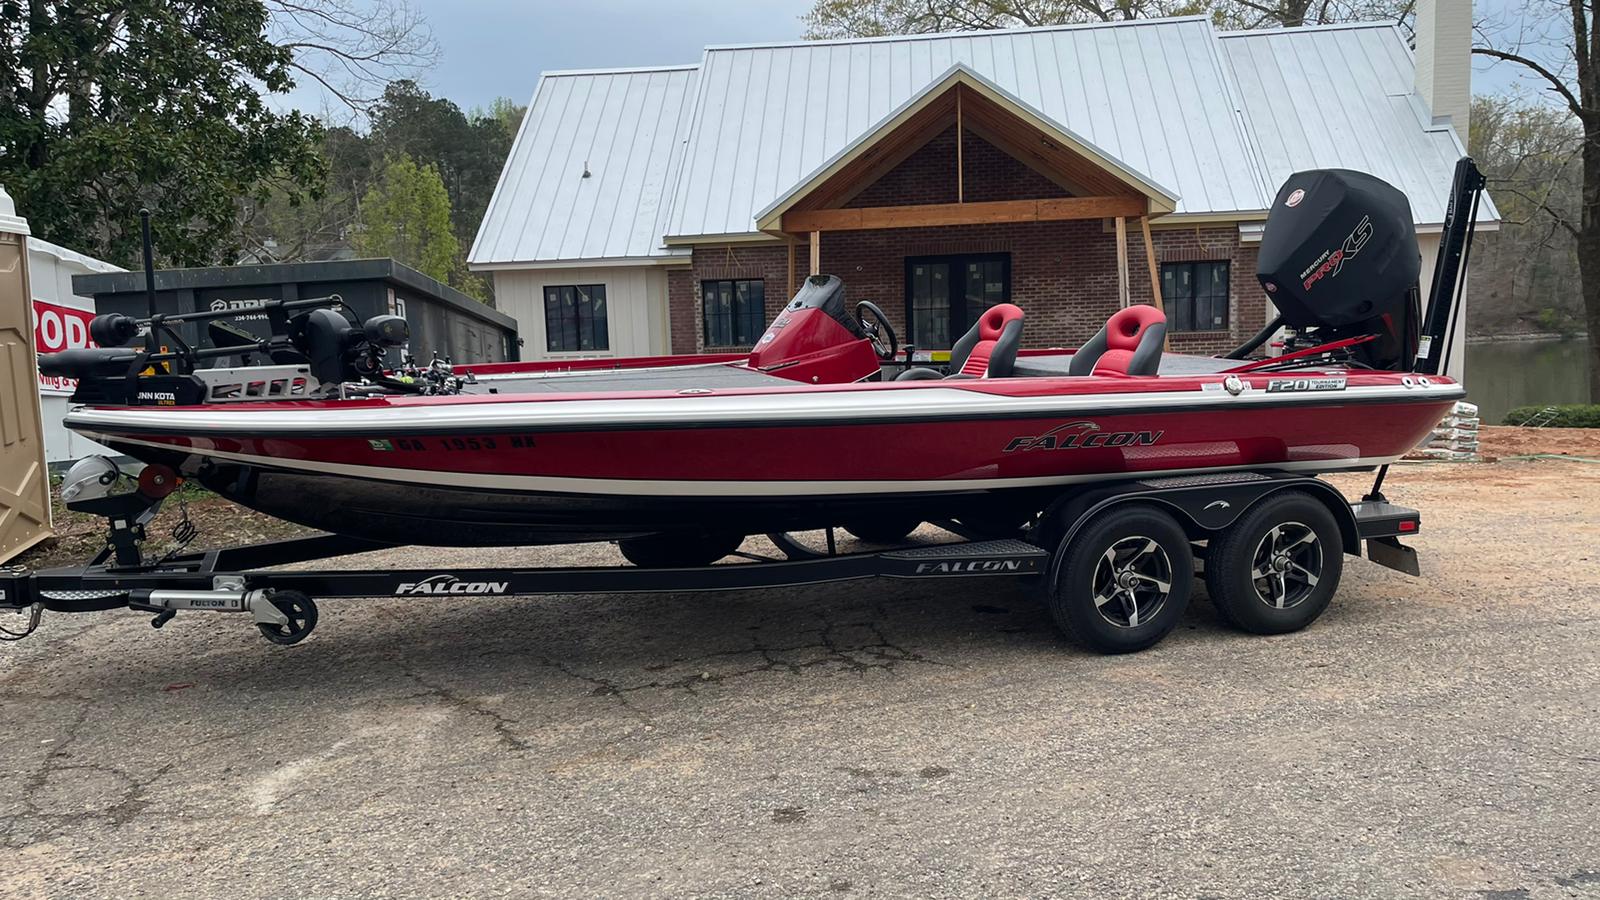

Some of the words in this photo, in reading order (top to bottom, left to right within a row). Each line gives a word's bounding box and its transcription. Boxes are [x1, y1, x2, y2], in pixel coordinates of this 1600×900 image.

[1300, 249, 1330, 279] MERCURY
[1268, 379, 1308, 391] F20
[154, 392, 175, 400] KOTA
[1002, 431, 1165, 452] FALCON
[916, 560, 1021, 573] FALCON
[395, 582, 509, 594] FALCON
